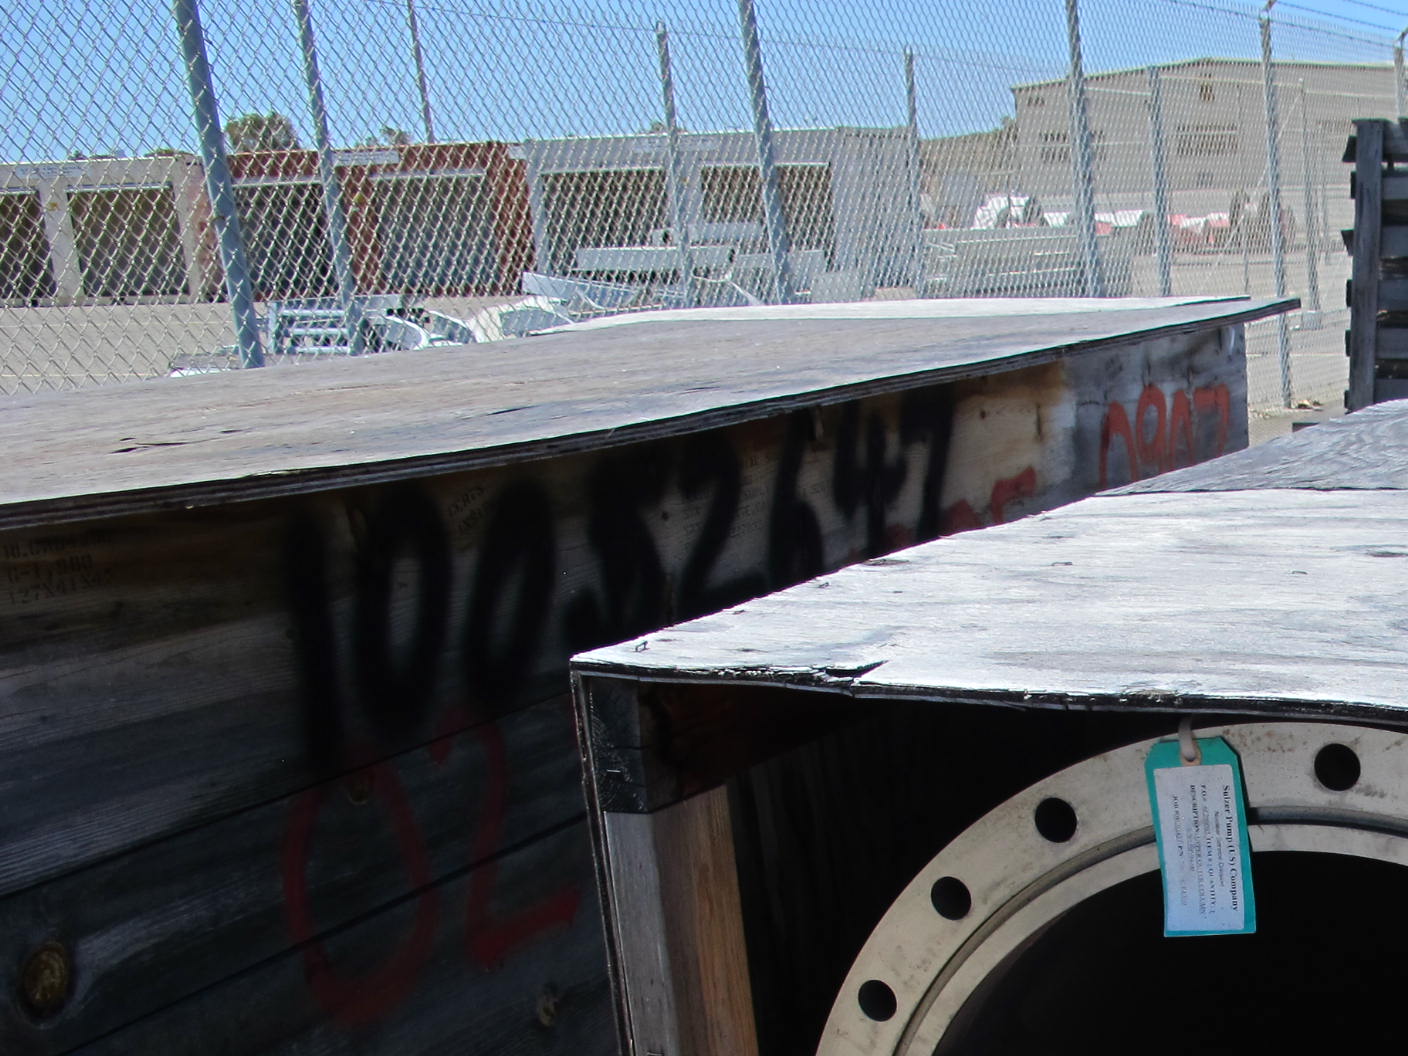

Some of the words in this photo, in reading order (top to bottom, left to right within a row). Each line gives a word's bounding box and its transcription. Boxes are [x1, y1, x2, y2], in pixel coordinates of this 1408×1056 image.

[1222, 784, 1231, 813] Sulzer
[1224, 816, 1233, 842] Pump
[1227, 845, 1235, 865] (US)
[1228, 868, 1239, 912] Company
